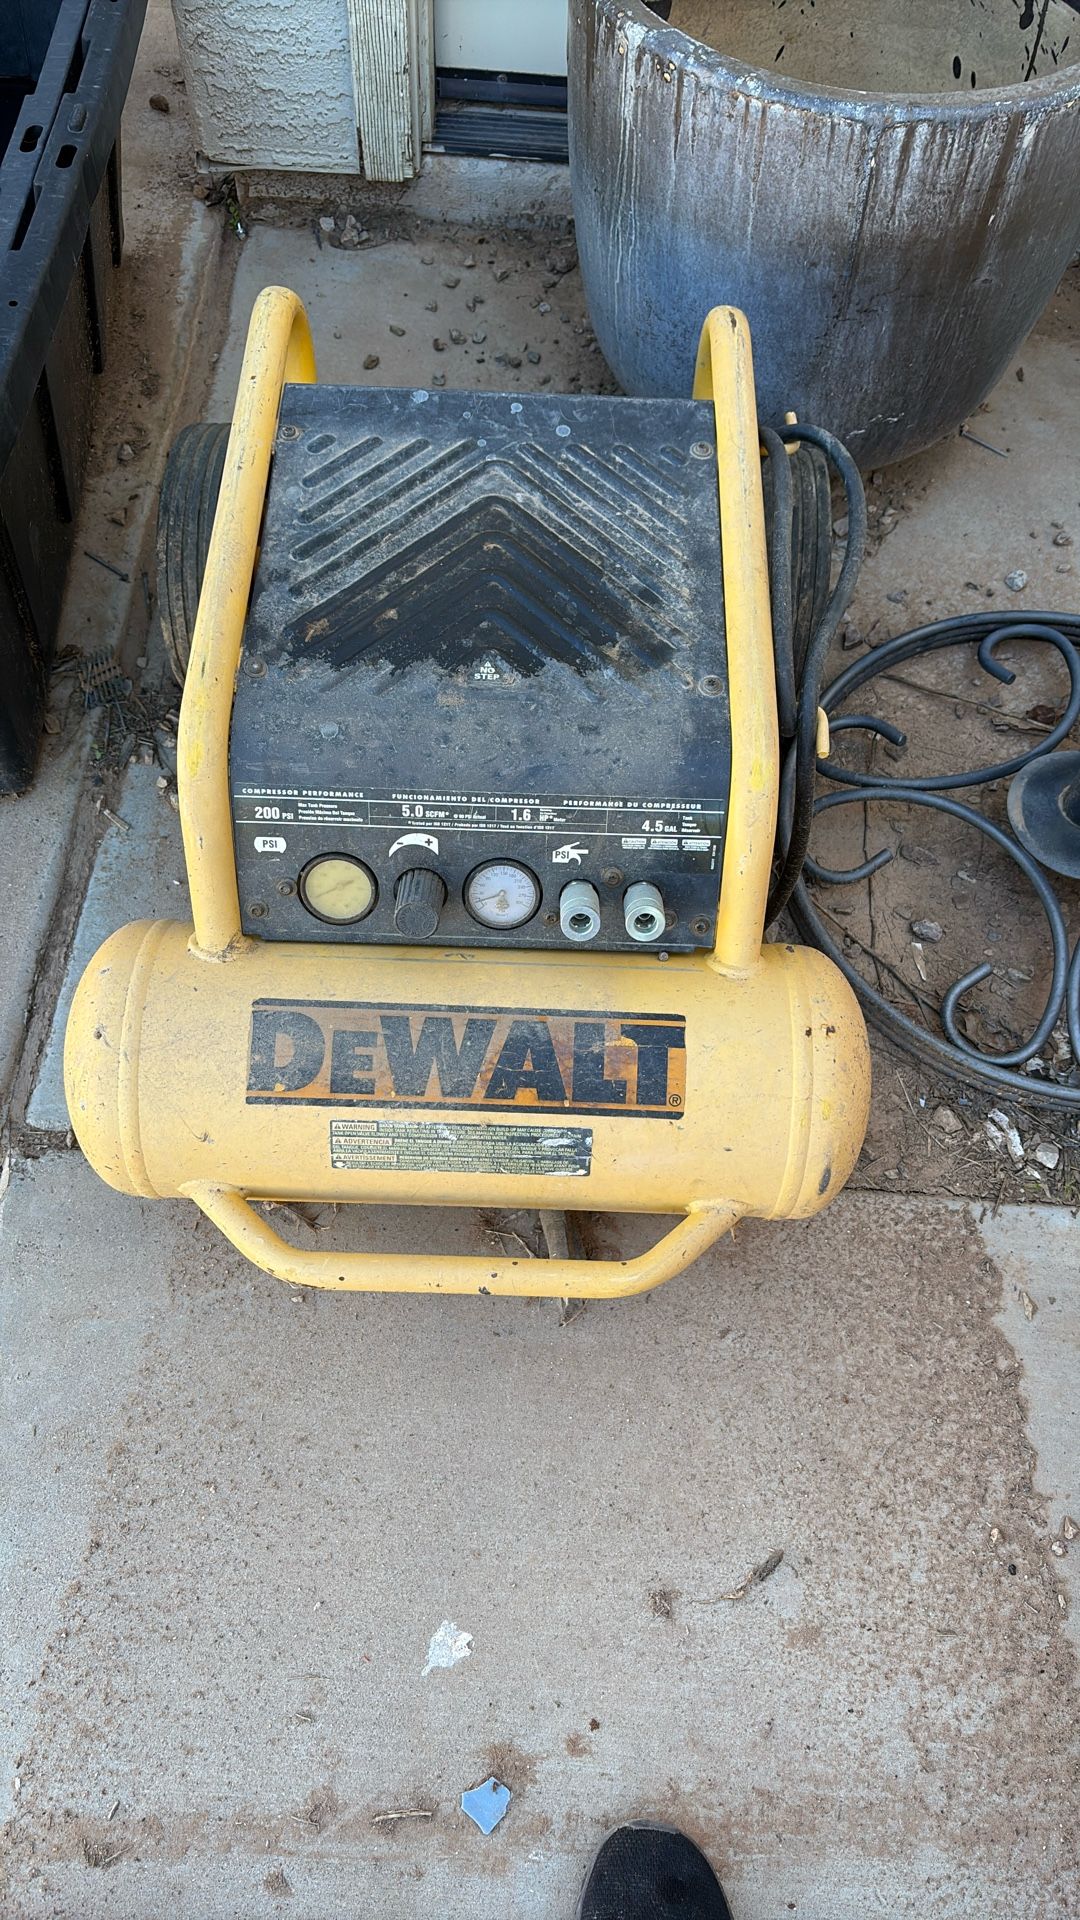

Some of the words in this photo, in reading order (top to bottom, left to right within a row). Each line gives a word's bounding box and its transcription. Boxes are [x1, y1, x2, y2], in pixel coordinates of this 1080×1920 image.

[242, 787, 299, 796] COMPRESSOR
[302, 790, 364, 798] PERFORMANCE
[392, 793, 468, 802] FUNCIONAMIENTO
[401, 804, 423, 817] 5.0
[563, 800, 624, 808] PERFORMANCE
[642, 802, 702, 810] COMPRESSEUR
[254, 806, 280, 820] 200
[511, 809, 531, 821] 1.6
[641, 820, 664, 832] 4.5
[262, 839, 278, 848] PSI
[554, 850, 570, 859] PSI
